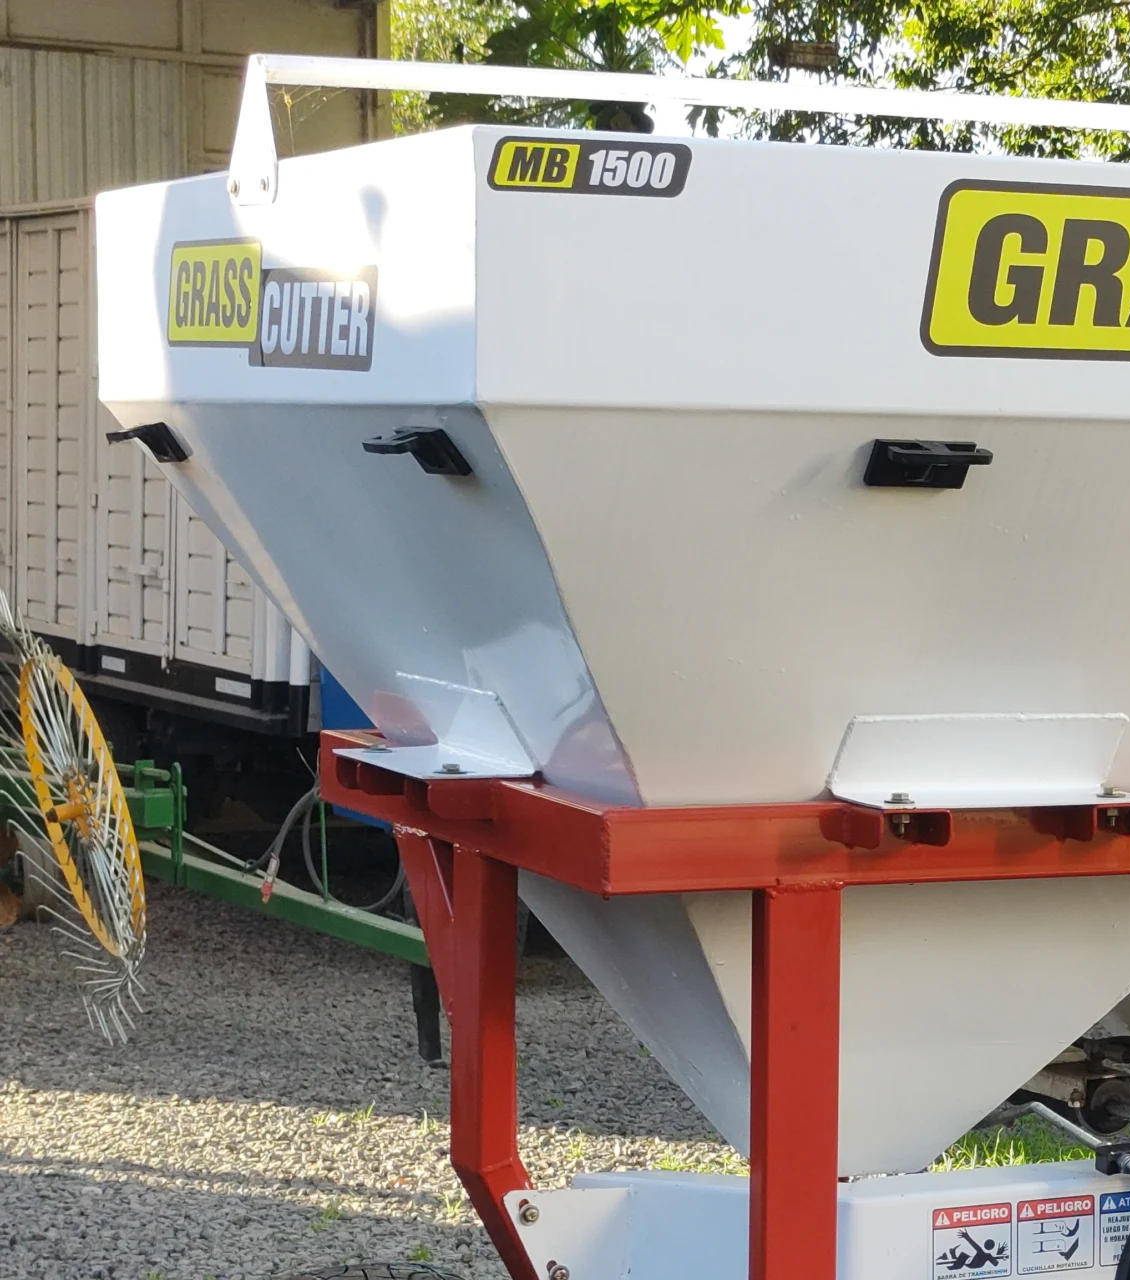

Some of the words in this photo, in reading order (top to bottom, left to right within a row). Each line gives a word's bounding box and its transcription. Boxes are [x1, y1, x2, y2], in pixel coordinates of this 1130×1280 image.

[506, 146, 571, 184] MB
[588, 149, 676, 189] 1500
[174, 256, 253, 329] GRASS
[260, 280, 371, 357] CUTTER
[952, 1207, 1009, 1223] PELIGRO
[1036, 1199, 1092, 1215] PELIGRO
[1021, 1263, 1056, 1273] CUCHILLAS
[1055, 1260, 1089, 1270] ROTATIVAS
